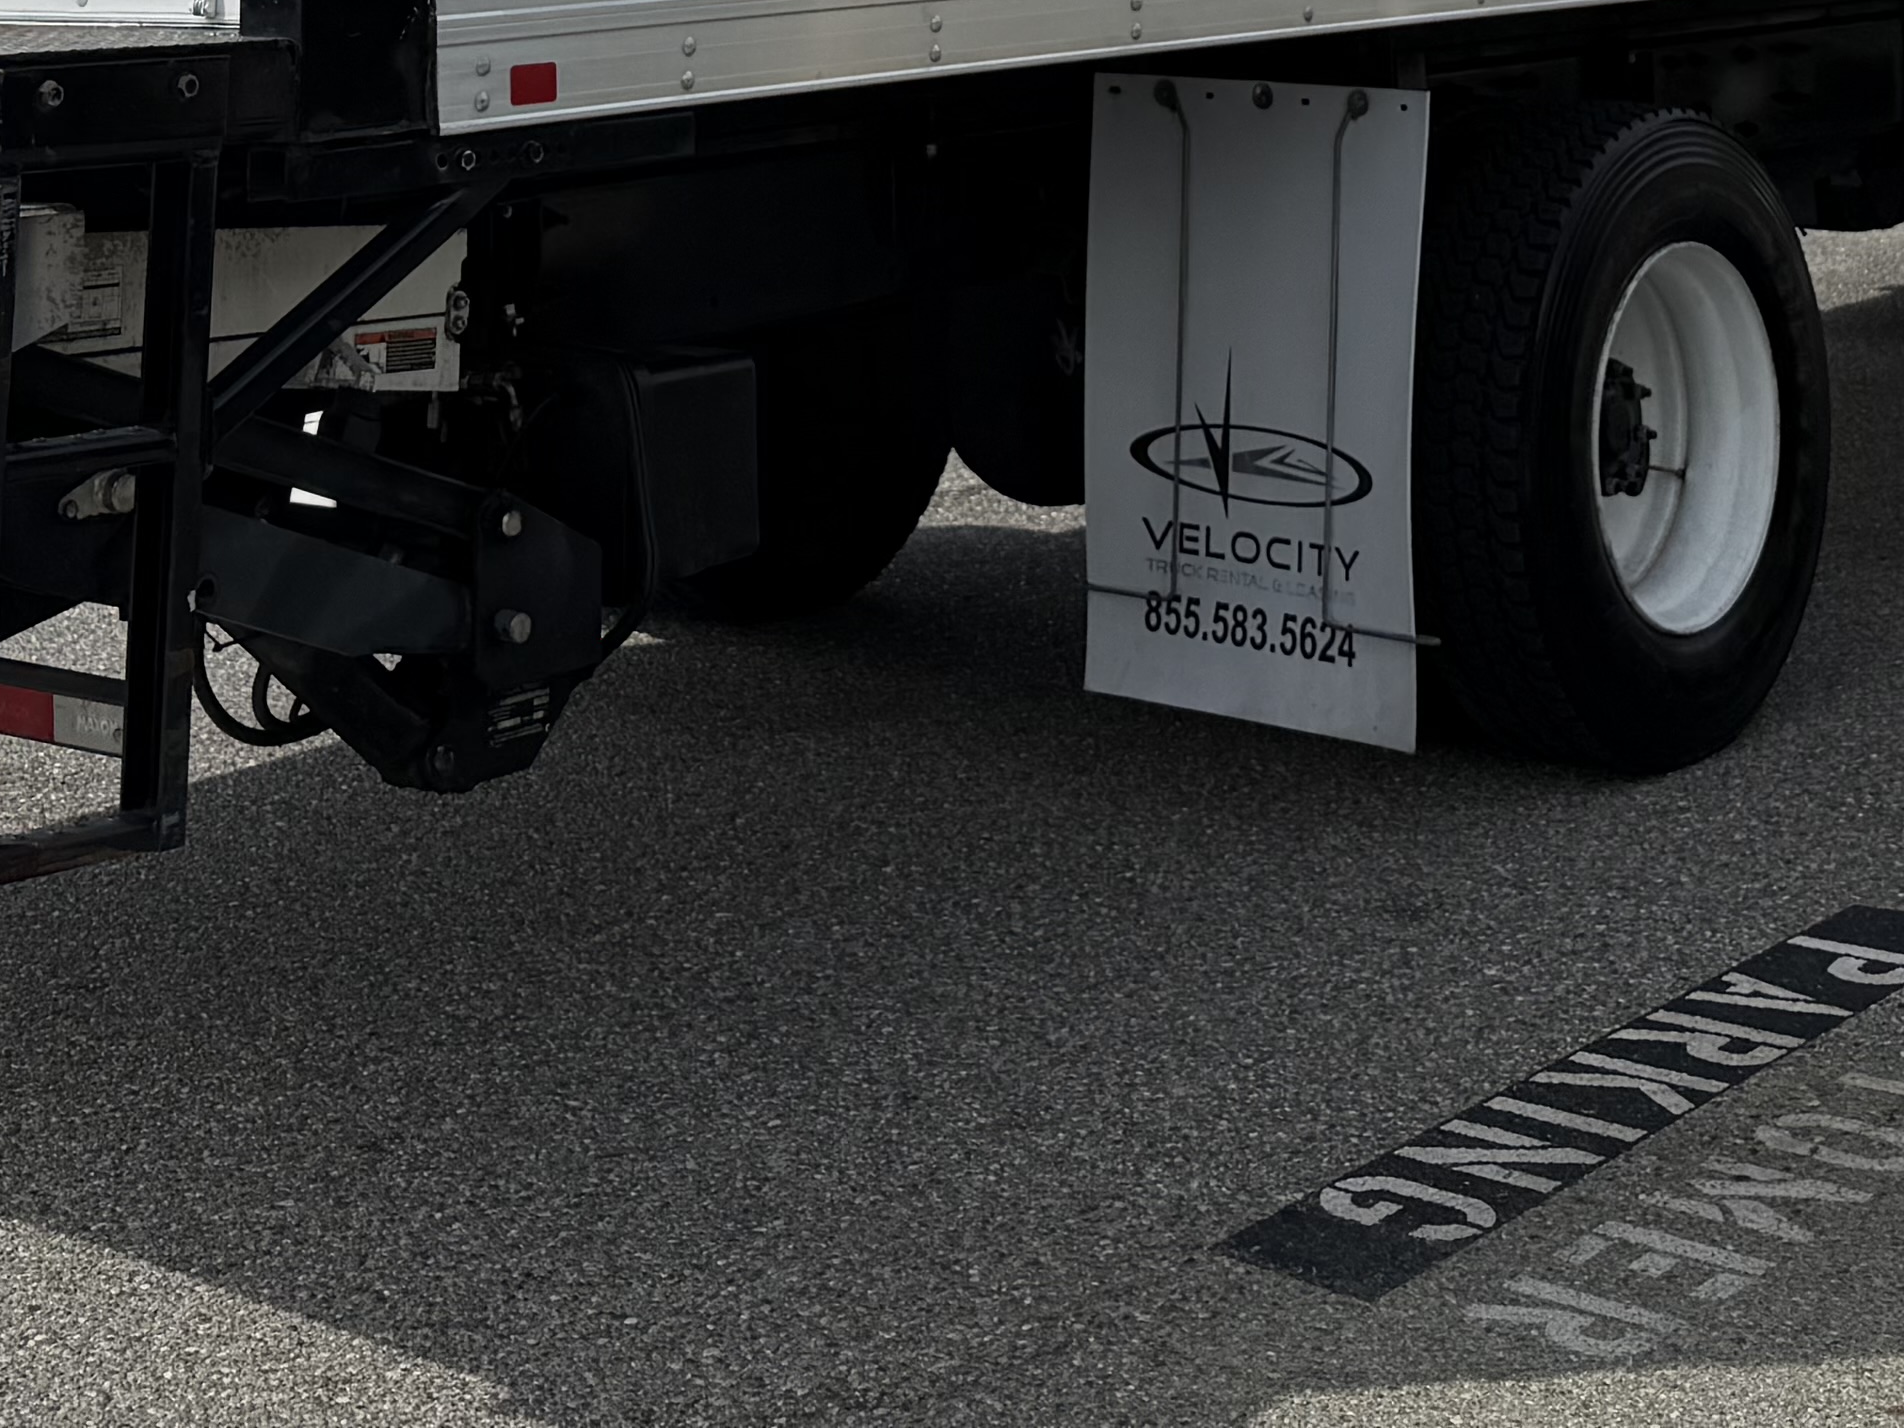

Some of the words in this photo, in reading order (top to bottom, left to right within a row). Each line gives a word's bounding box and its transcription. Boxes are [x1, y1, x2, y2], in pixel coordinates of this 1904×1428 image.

[1142, 516, 1360, 581] VELOCITY
[1145, 556, 1203, 580] TRCK
[1144, 590, 1357, 668] 855.583.5624
